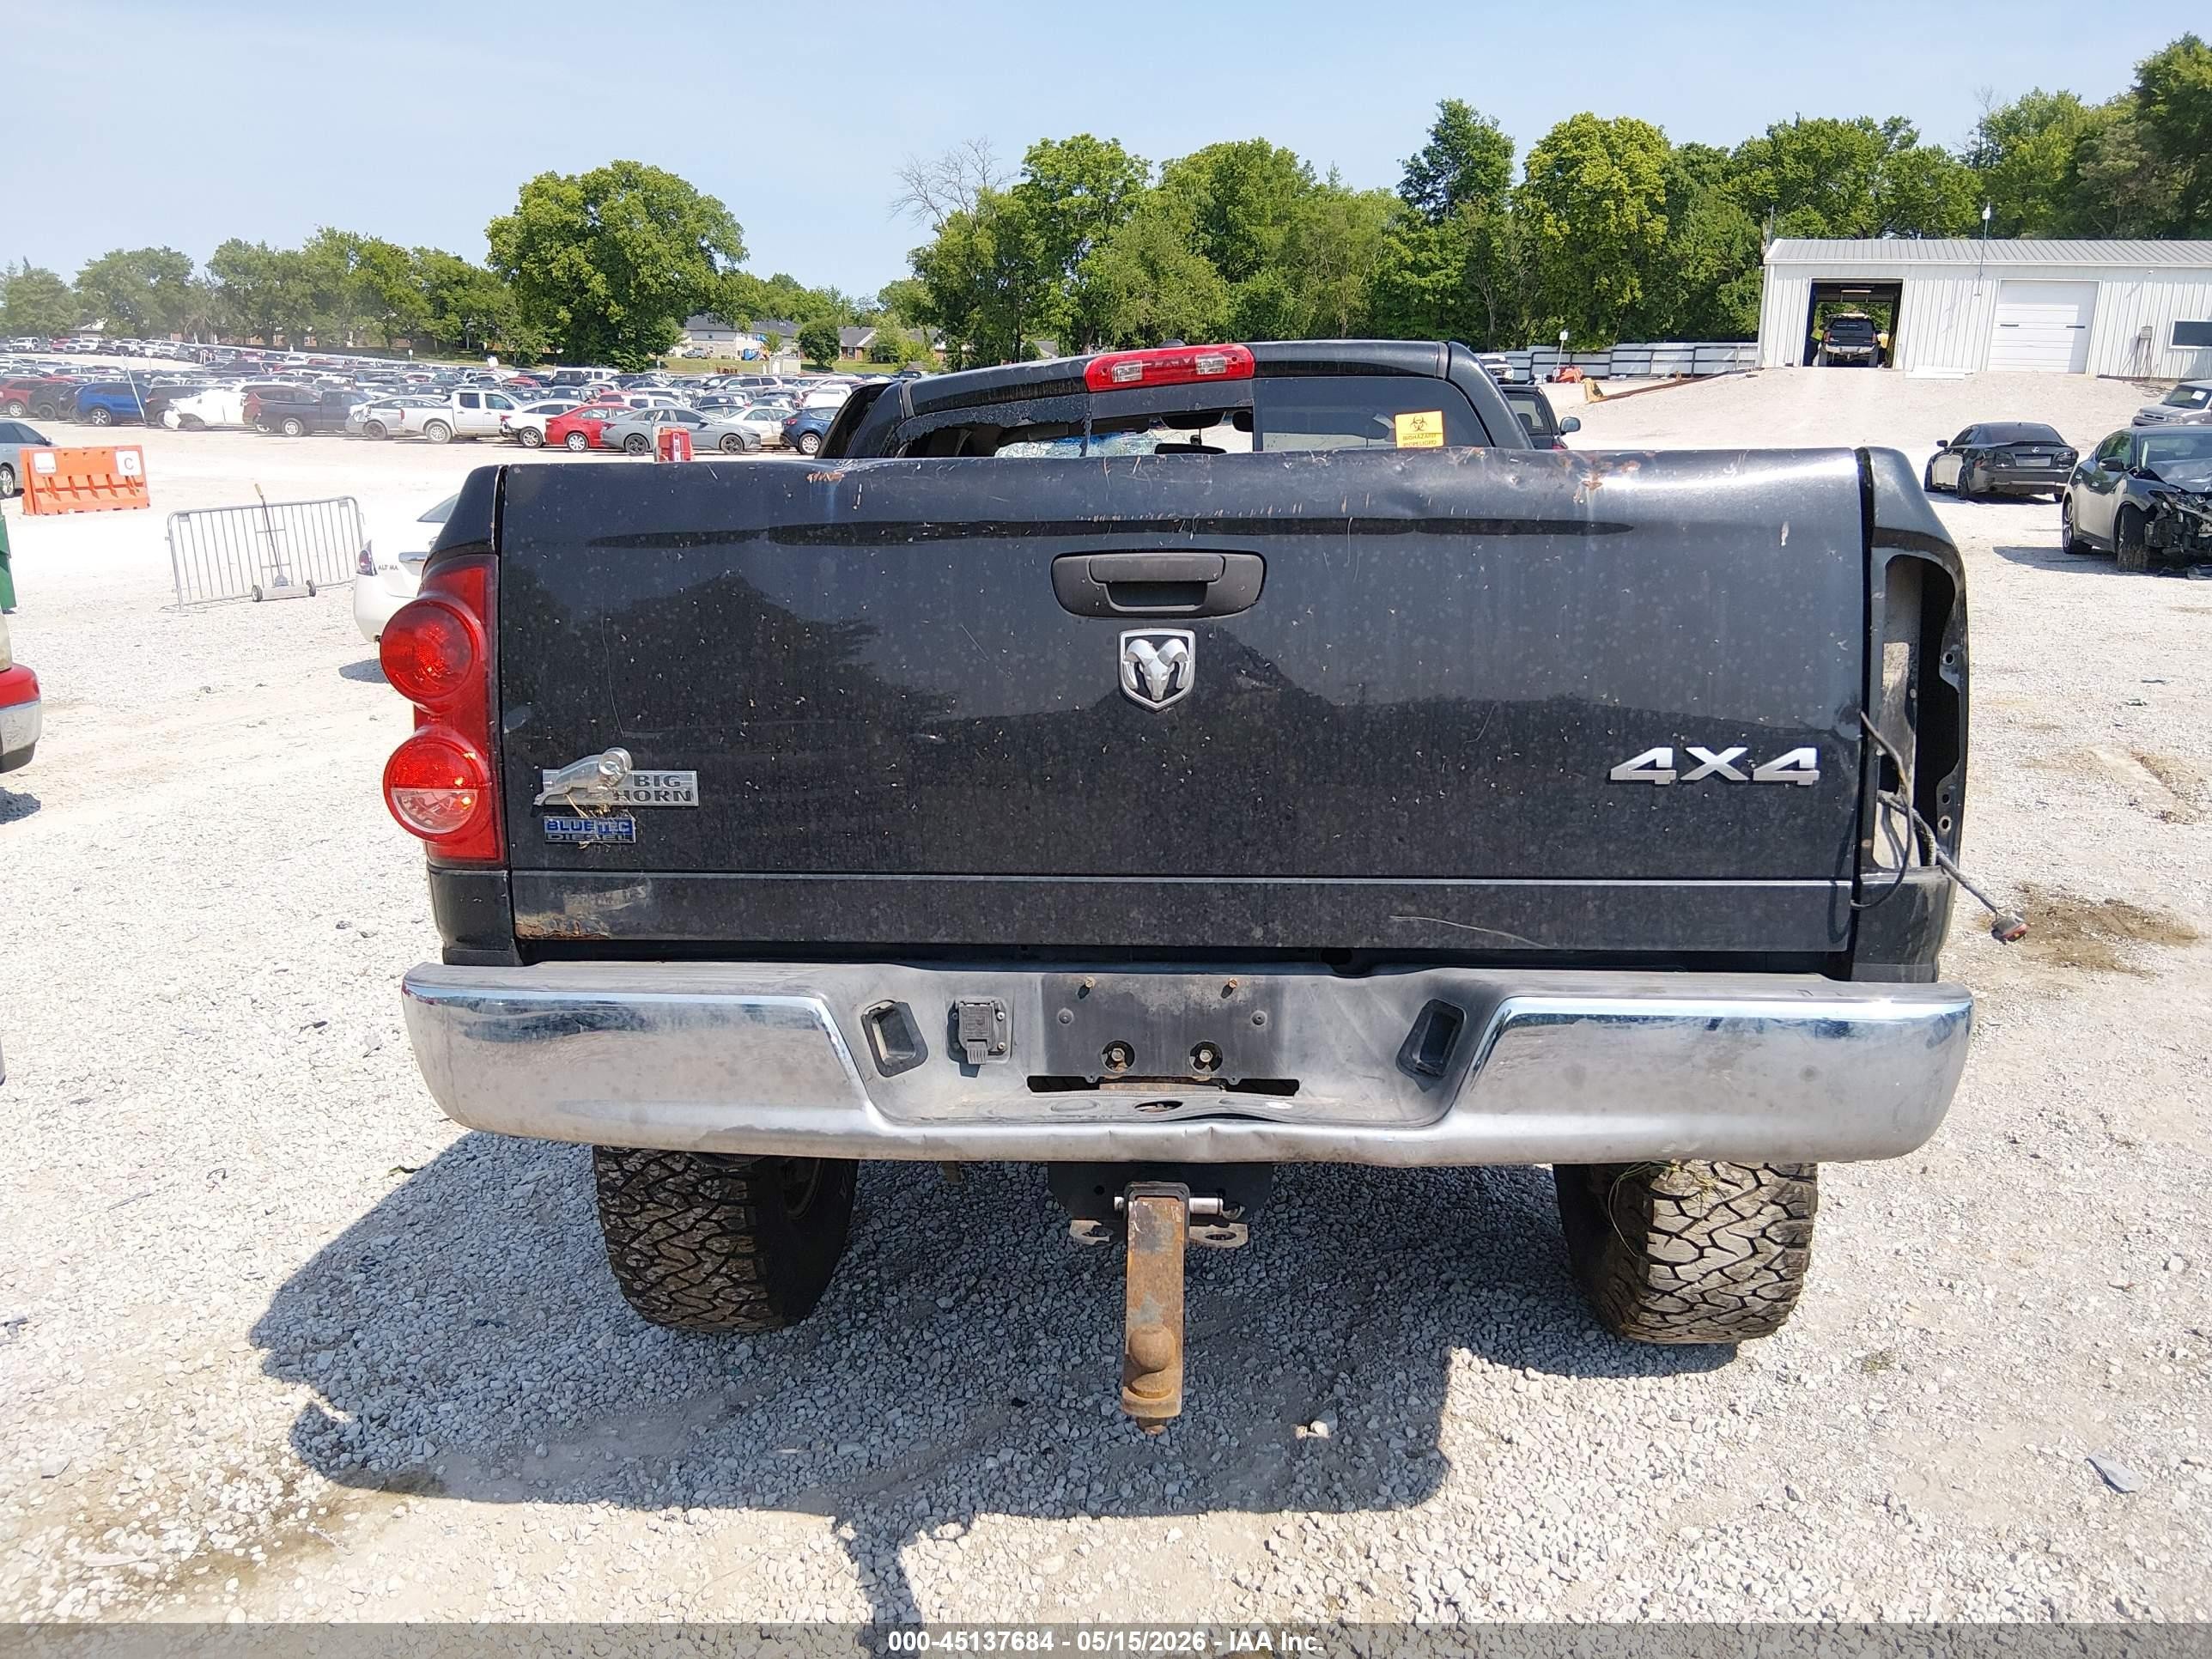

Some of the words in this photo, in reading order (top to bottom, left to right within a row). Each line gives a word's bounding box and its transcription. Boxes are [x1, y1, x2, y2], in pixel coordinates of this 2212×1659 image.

[124, 457, 134, 471] C
[1610, 746, 1820, 786] 4X4
[633, 775, 681, 787] BIG
